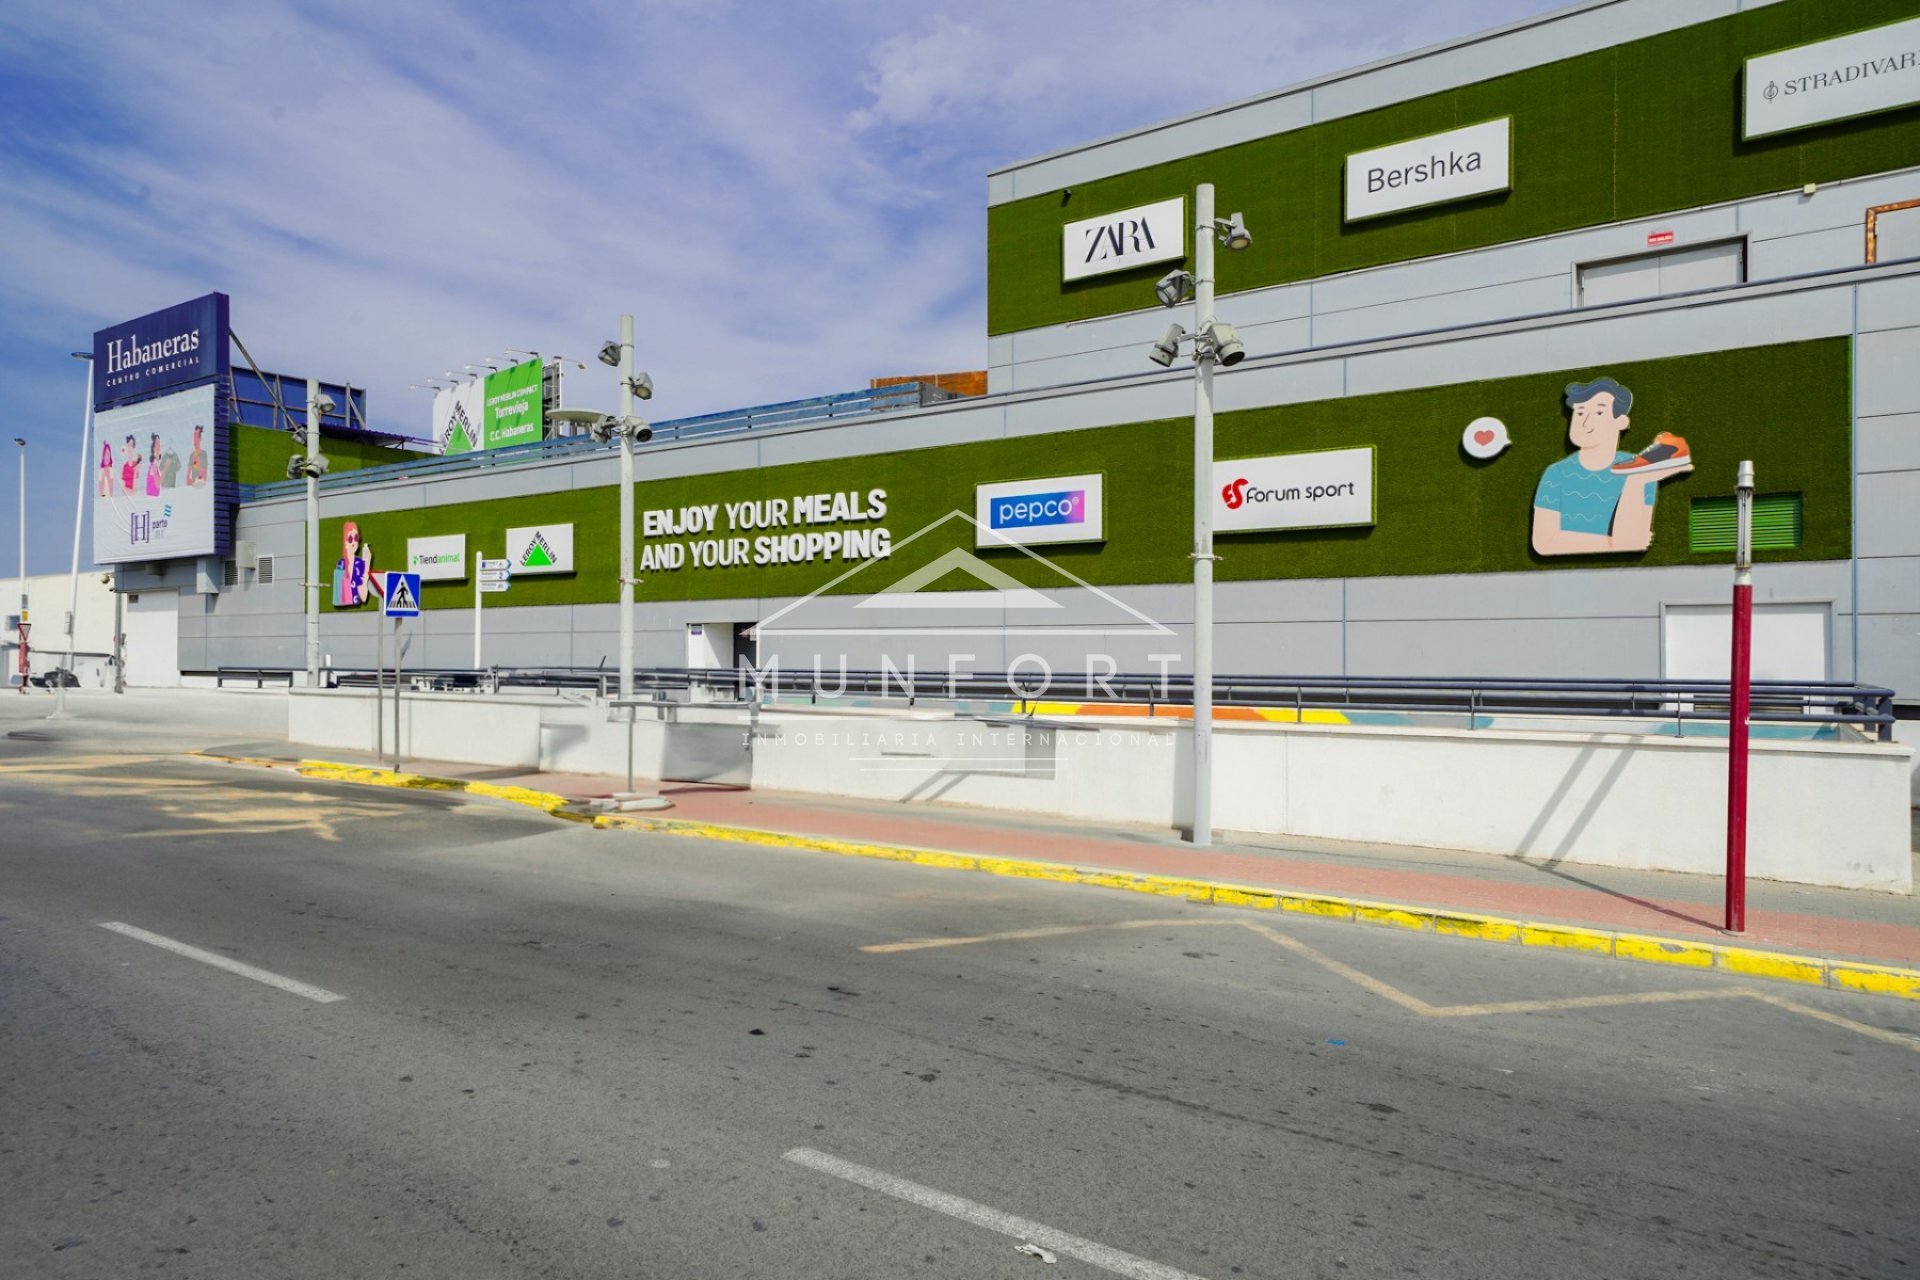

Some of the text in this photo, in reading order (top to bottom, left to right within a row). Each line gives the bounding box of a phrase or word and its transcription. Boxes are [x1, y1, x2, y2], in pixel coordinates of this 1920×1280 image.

[1368, 151, 1481, 193] Bershka
[1085, 216, 1156, 264] ZARA
[107, 328, 199, 374] Habaneras
[106, 356, 200, 387] CENTRO COMERCIAL
[455, 400, 478, 448] MERLIN
[495, 399, 529, 419] Torrevieja
[1305, 482, 1355, 502] sport
[643, 488, 888, 538] ENJOY YOUR MEALS
[419, 553, 460, 565] Tiendanimal
[519, 538, 537, 566] LEROY
[535, 531, 558, 564] MERLIN
[640, 527, 892, 571] AND YOUR SHOPPING
